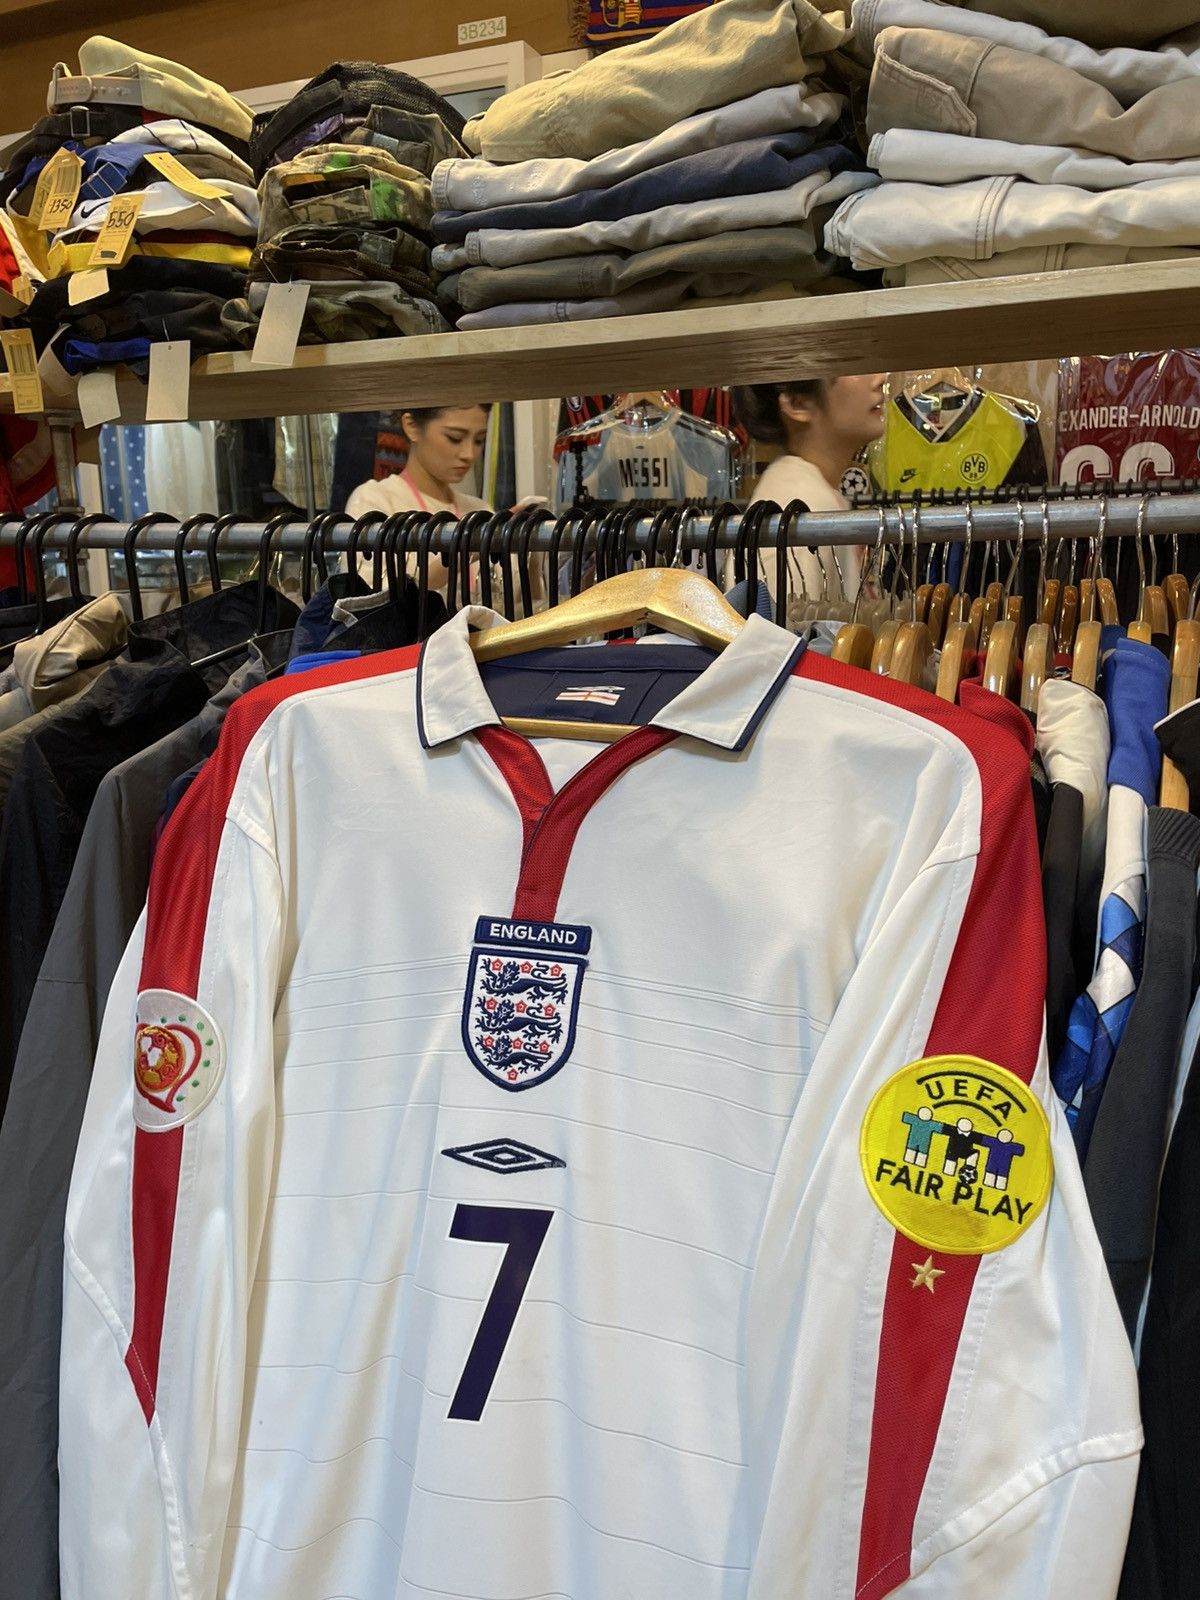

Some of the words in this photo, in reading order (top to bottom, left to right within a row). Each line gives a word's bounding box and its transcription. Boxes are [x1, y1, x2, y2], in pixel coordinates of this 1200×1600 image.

[459, 18, 505, 41] 3B234
[106, 210, 135, 228] 550
[618, 457, 668, 488] MESSI
[963, 455, 986, 473] BVB
[489, 922, 577, 945] ENGLAND
[924, 1078, 1013, 1121] UEFA
[875, 1158, 944, 1200] FAIR
[952, 1182, 1033, 1225] PLAY
[447, 1202, 555, 1422] 7
